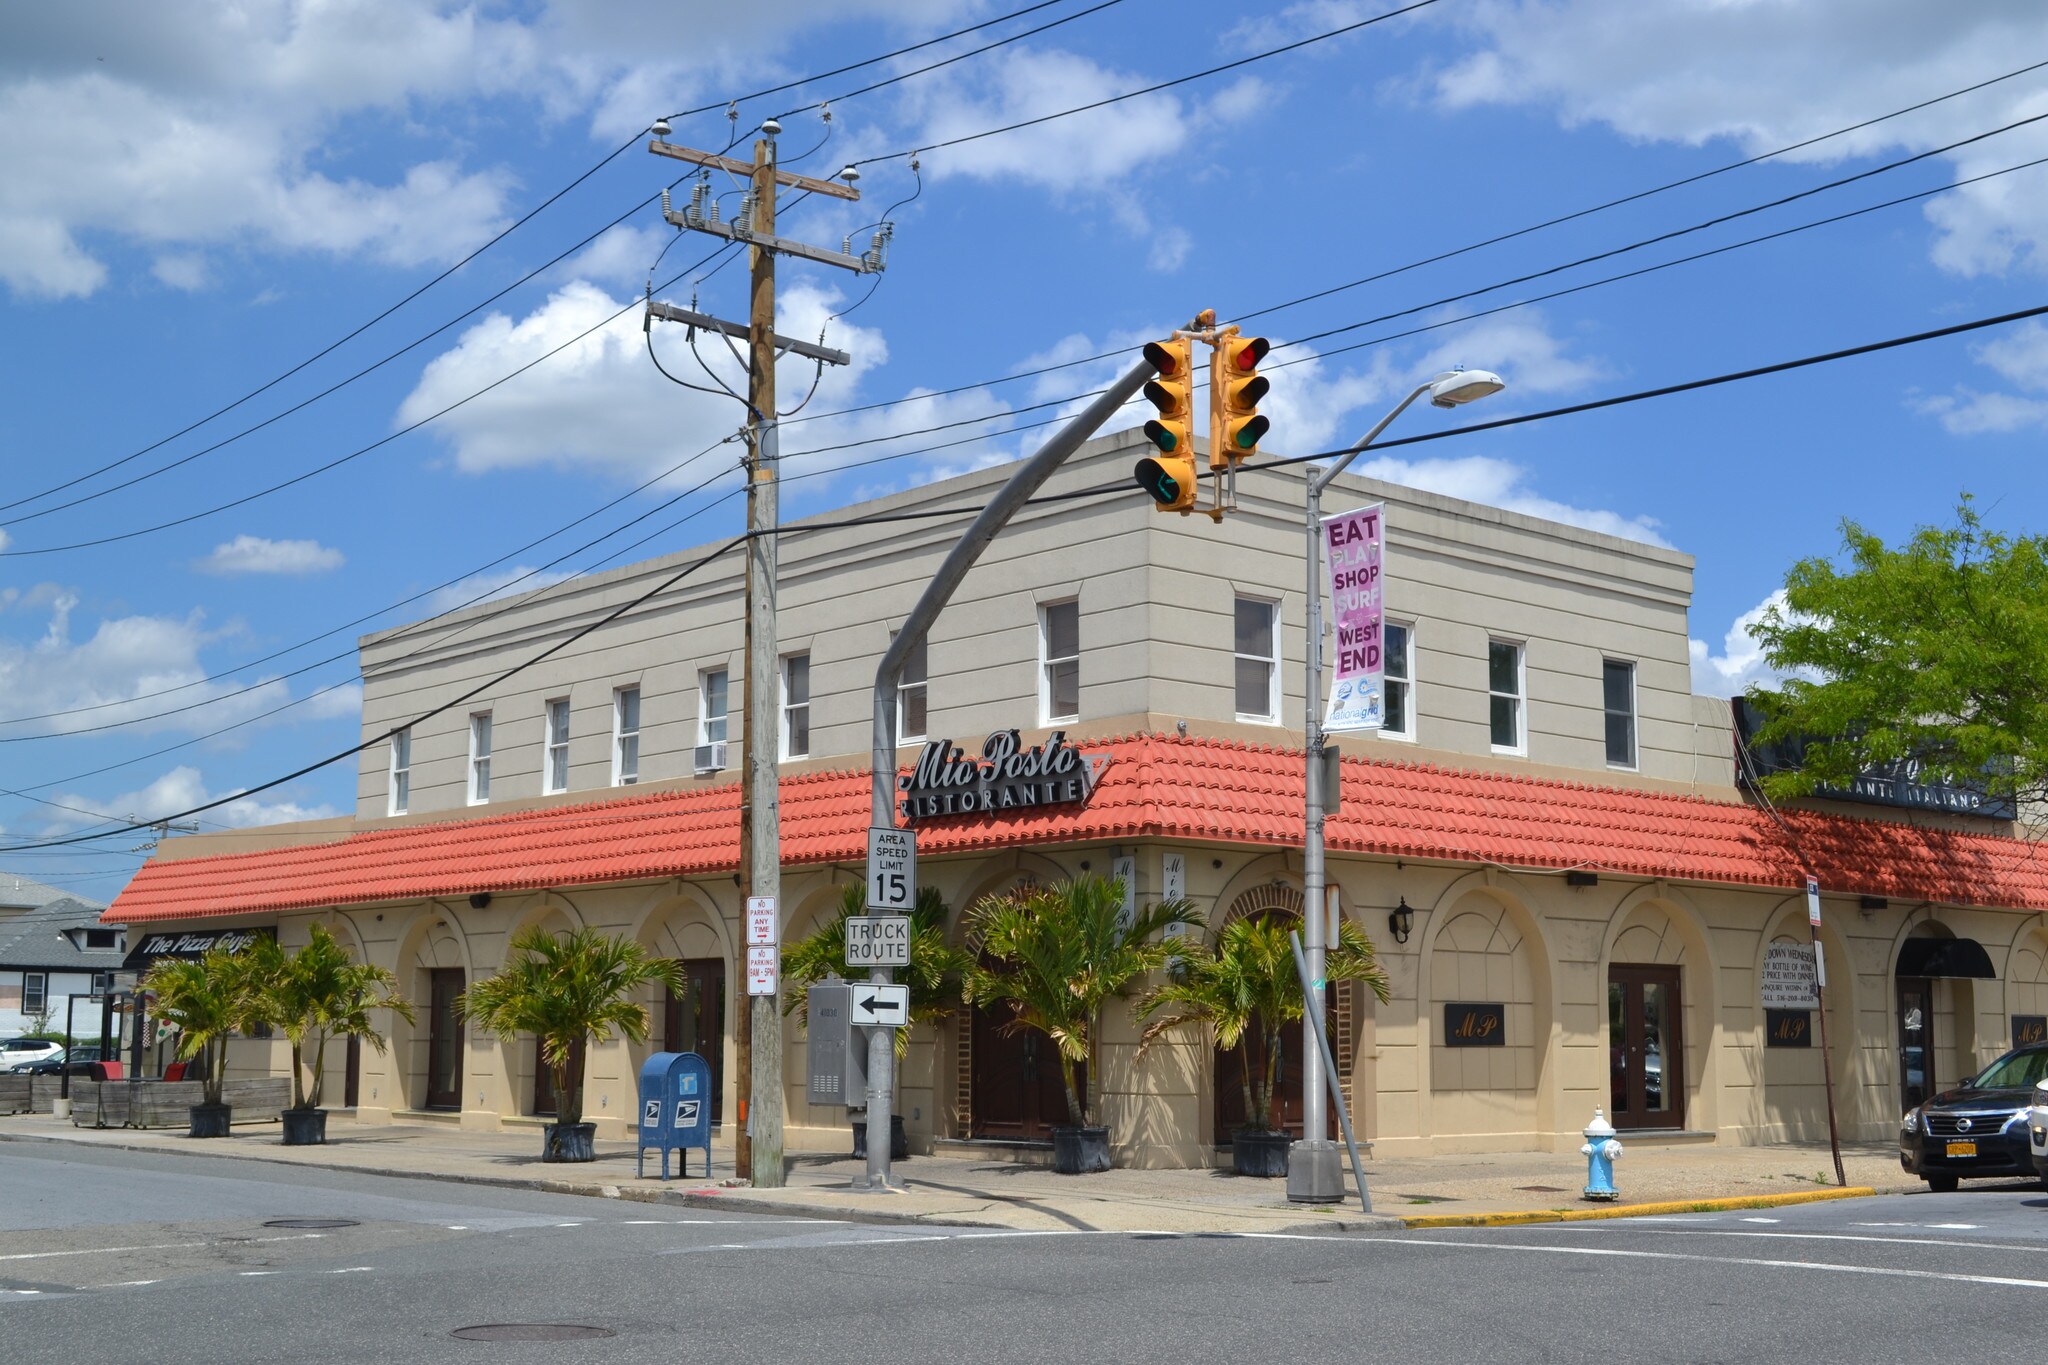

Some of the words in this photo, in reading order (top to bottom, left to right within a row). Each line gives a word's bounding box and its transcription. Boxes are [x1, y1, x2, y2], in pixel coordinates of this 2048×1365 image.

[1329, 515, 1377, 547] EAT
[1332, 542, 1379, 569] PLAY
[1334, 566, 1379, 590] SHOP
[1336, 588, 1380, 613] SURF
[1339, 623, 1380, 647] WEST
[1340, 645, 1380, 673] END
[898, 739, 978, 792] Mio
[980, 729, 1082, 782] Posto
[901, 779, 1084, 818] RISTORANTE
[1907, 788, 1981, 809] ITALIANO
[878, 834, 906, 846] AREA
[876, 847, 908, 859] SPEED
[879, 860, 904, 871] LIMIT
[876, 873, 907, 903] 15
[750, 909, 774, 917] PARKING
[850, 924, 906, 939] TRUCK
[143, 936, 174, 954] The
[171, 934, 215, 953] Pizza
[215, 932, 257, 954] Guys
[849, 943, 906, 958] ROUTE
[1766, 971, 1781, 979] PRICE
[1782, 971, 1796, 980] WITH
[1797, 972, 1814, 980] DINNER
[1772, 962, 1790, 971] BOTTLE
[1800, 963, 1812, 972] WINE
